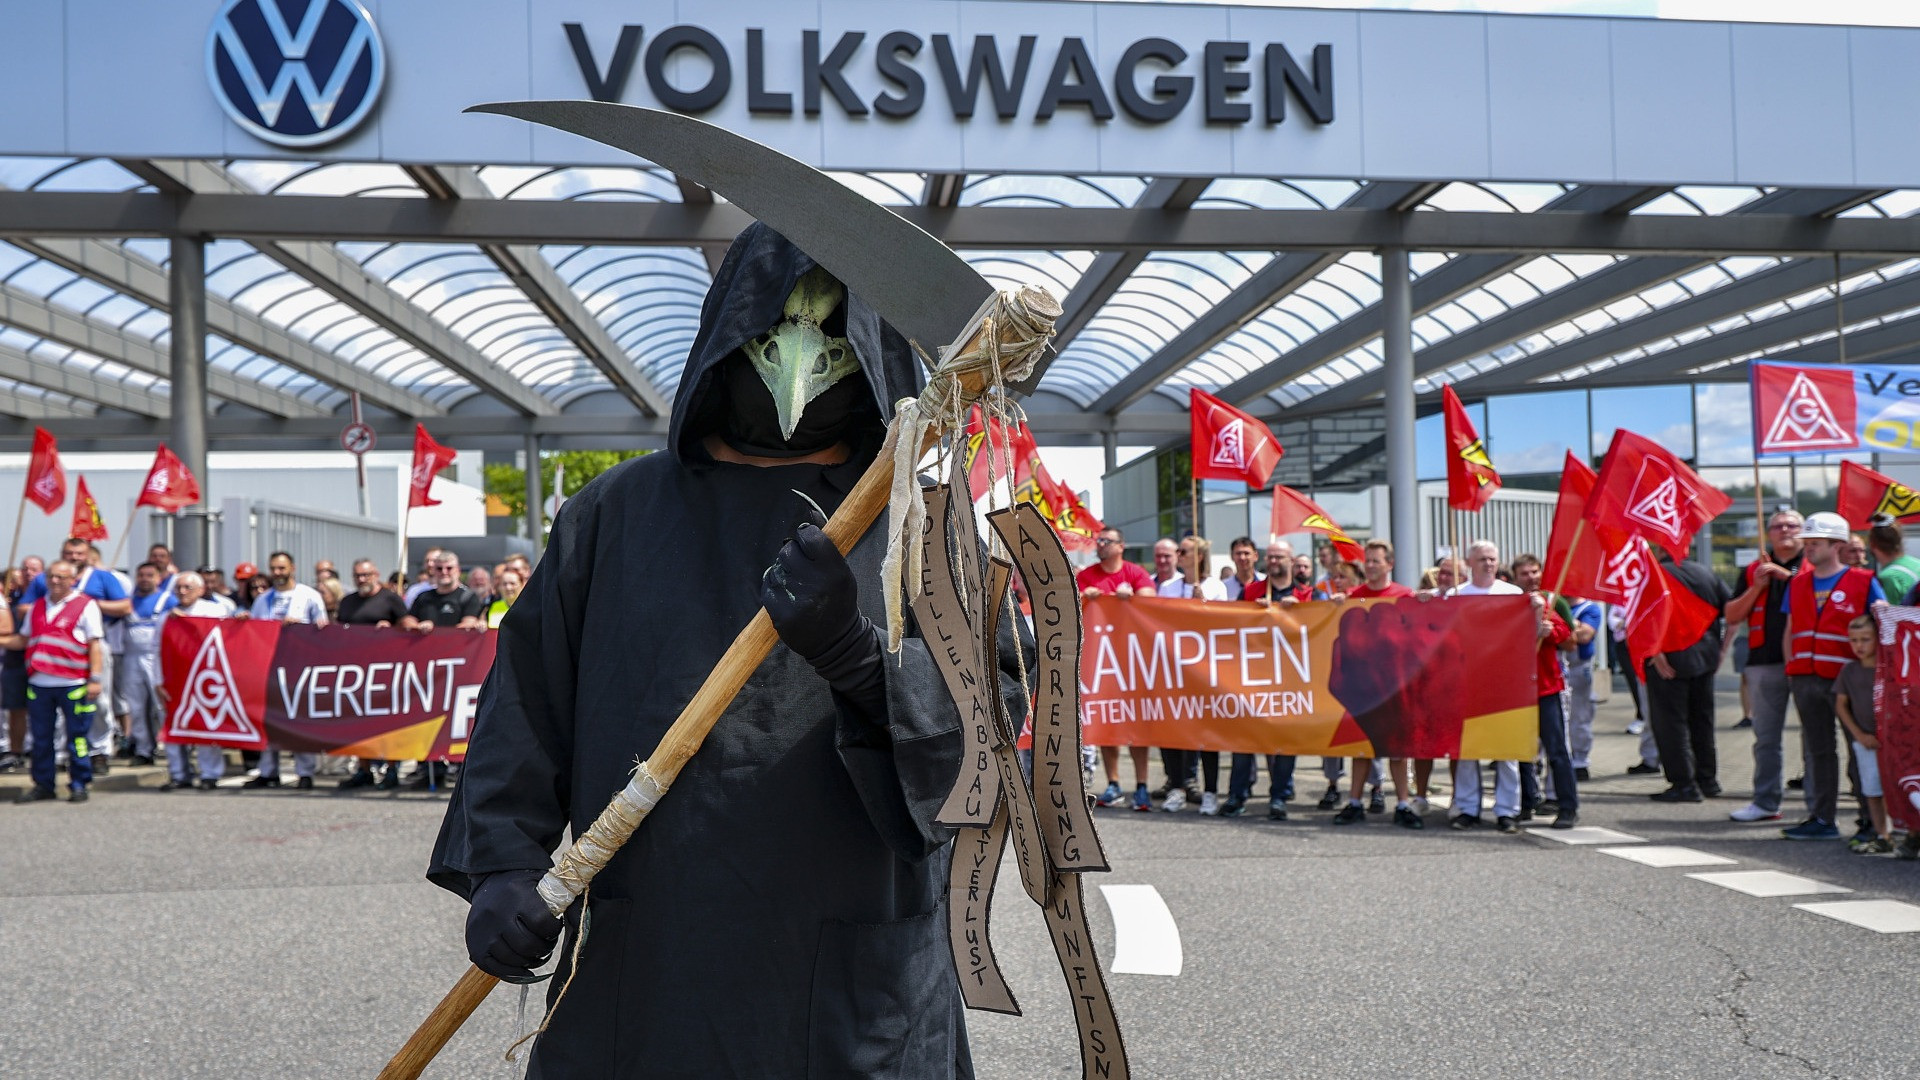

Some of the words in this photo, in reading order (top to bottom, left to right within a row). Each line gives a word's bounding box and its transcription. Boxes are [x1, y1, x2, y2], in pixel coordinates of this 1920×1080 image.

[563, 23, 1334, 125] VOLKSWAGEN
[277, 657, 466, 720] VEREINT
[1018, 523, 1081, 862] AUSGRENZUNG
[1140, 697, 1165, 721] IM
[1168, 690, 1314, 720] VW-KONZERN
